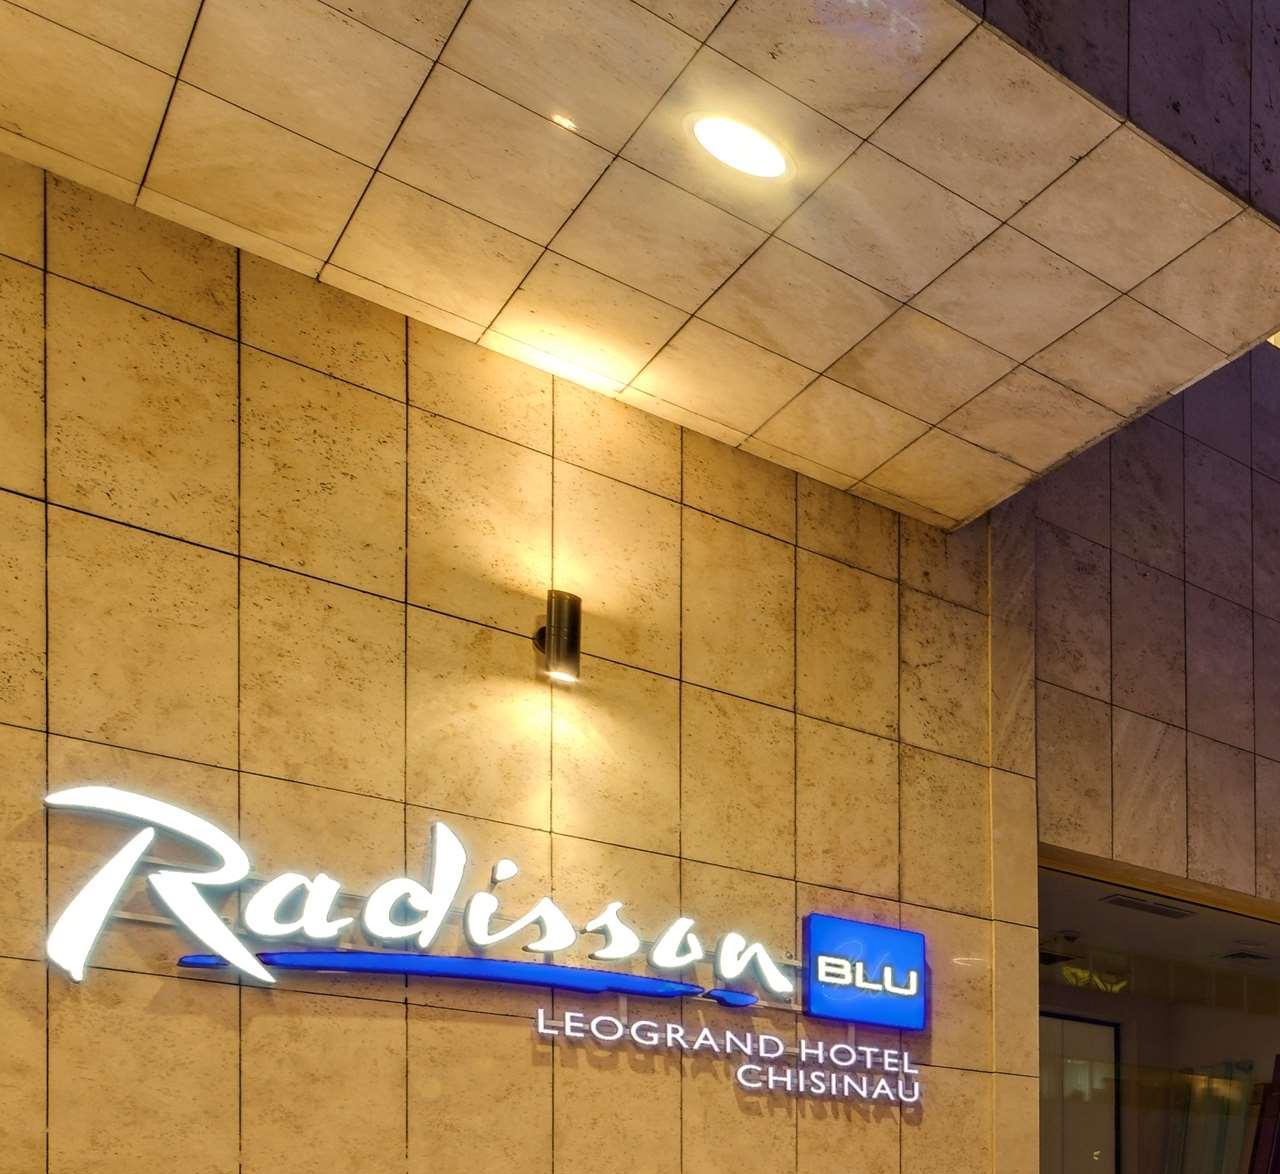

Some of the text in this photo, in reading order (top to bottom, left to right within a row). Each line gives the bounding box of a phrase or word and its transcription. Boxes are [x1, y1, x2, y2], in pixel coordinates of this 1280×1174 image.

[43, 785, 919, 996] Radisson BLU
[535, 1008, 919, 1074] LEOGRAND HOTEL
[736, 1063, 920, 1103] CHISINAU
